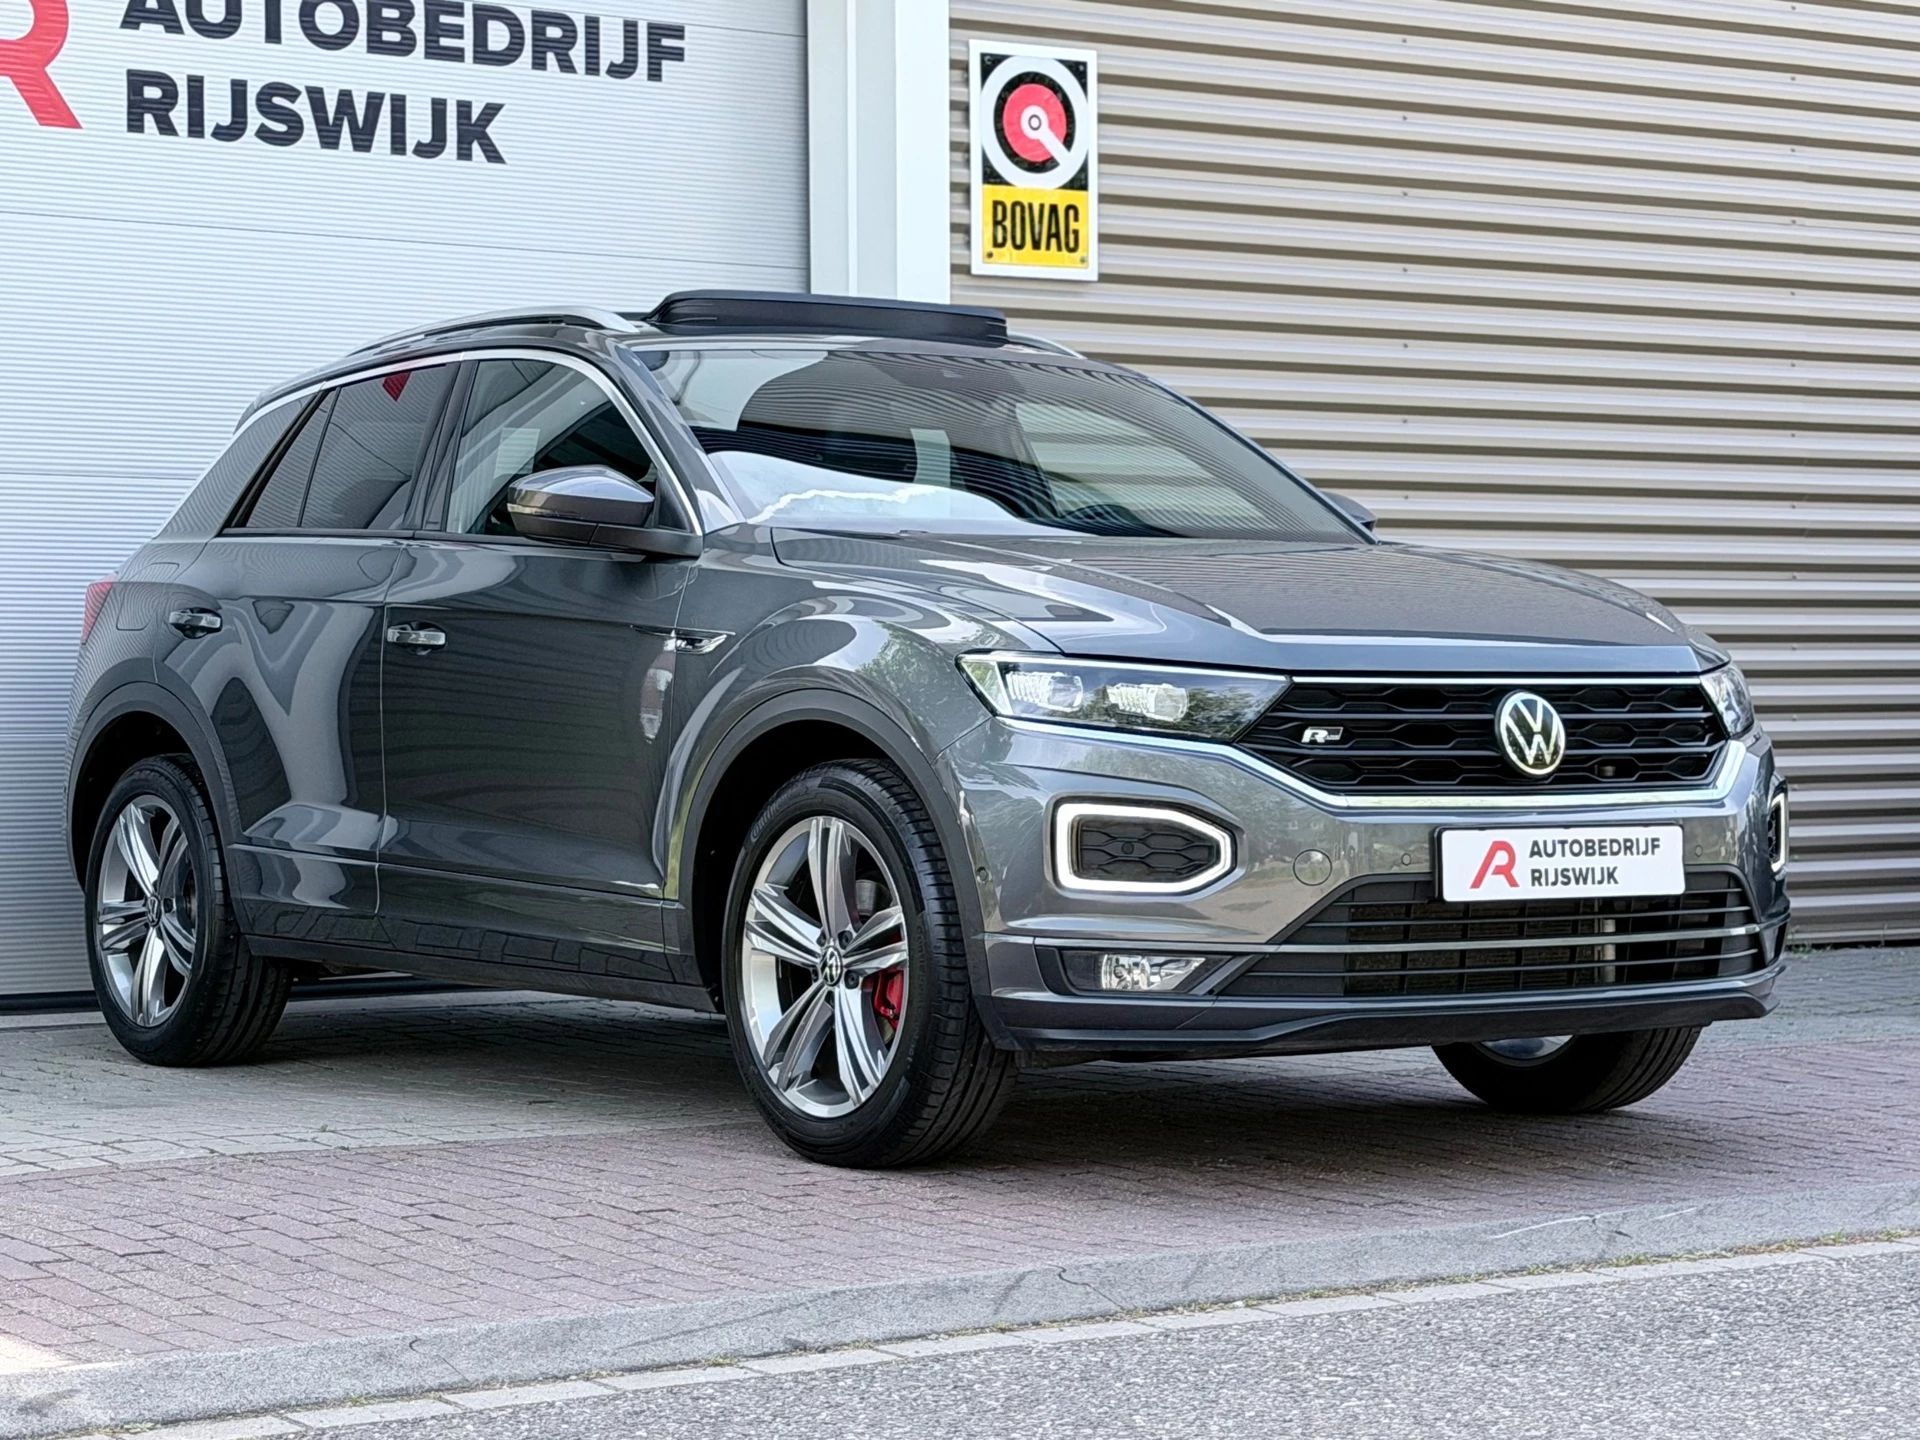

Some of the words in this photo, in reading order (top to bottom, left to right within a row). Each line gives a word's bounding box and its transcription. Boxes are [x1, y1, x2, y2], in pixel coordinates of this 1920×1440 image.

[126, 68, 507, 165] RIJSWIJK
[991, 200, 1080, 254] BOVAG
[1529, 837, 1661, 858] AUTOBEDRIJF
[1530, 866, 1619, 887] RIJSWIJK
